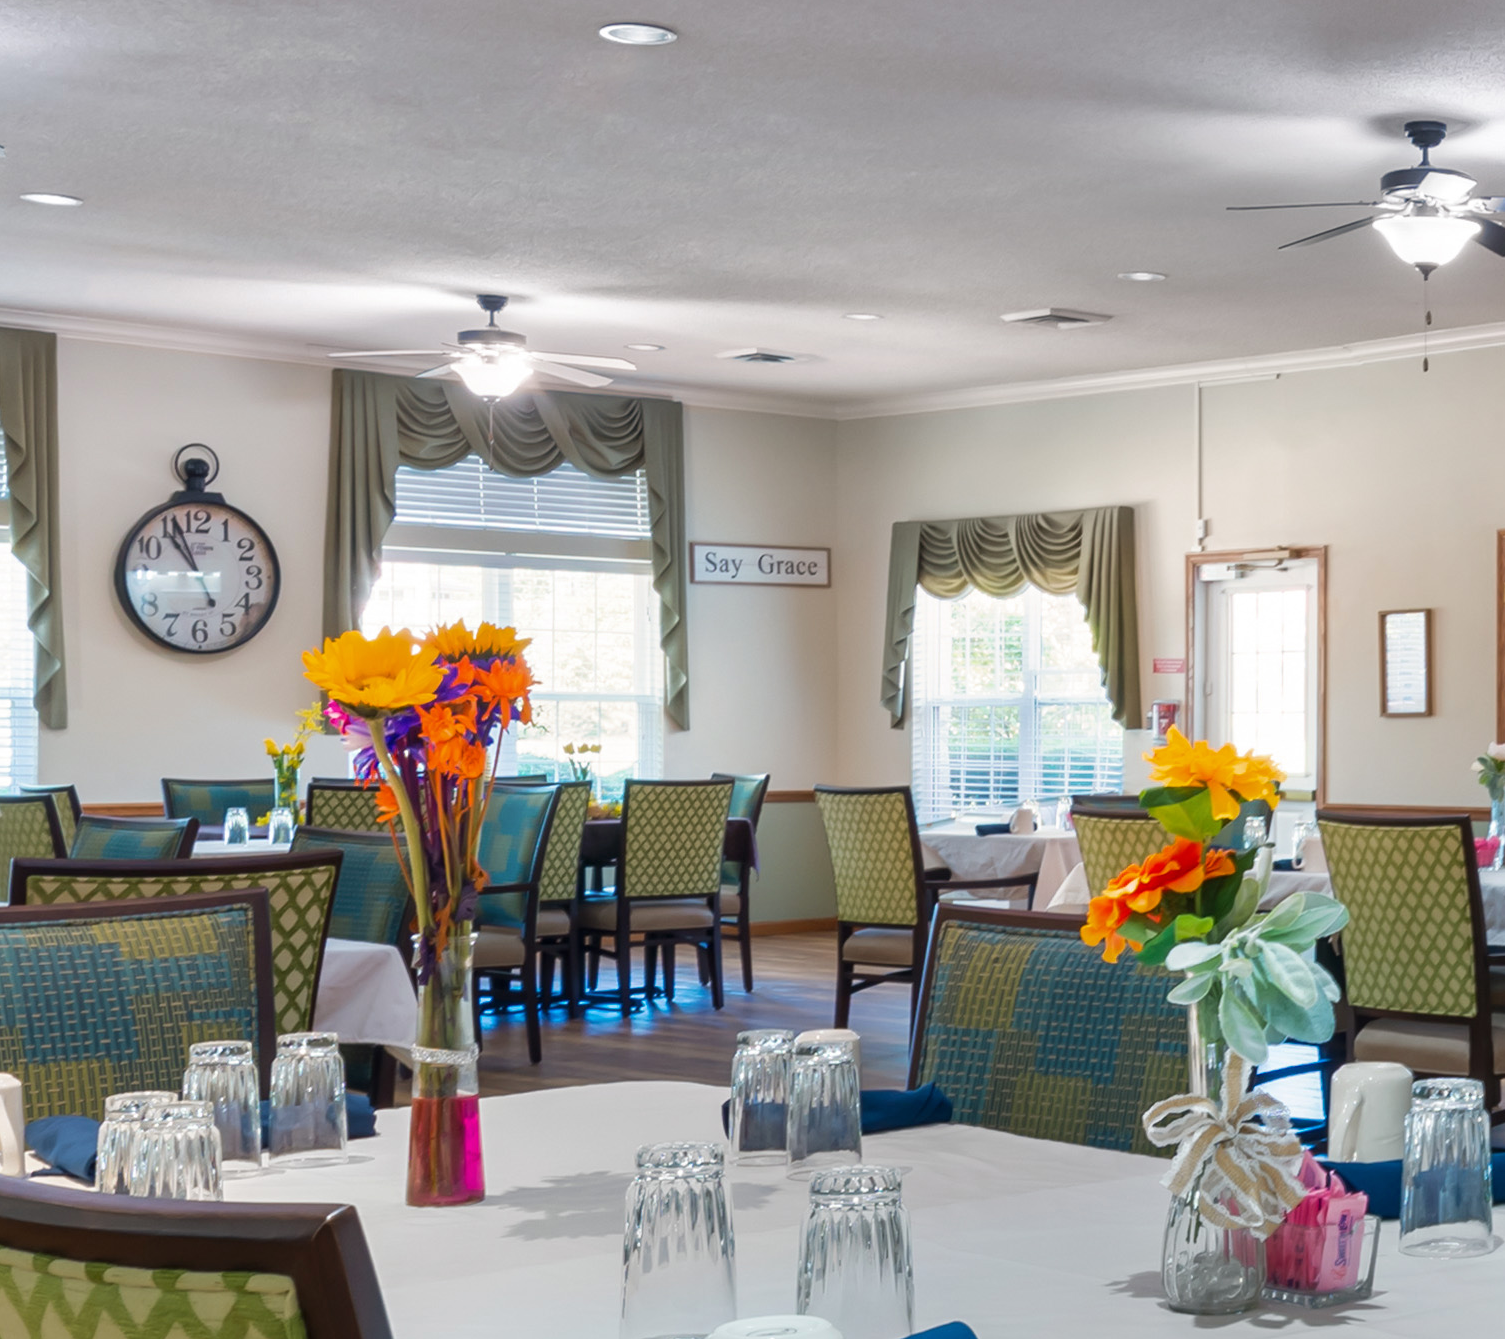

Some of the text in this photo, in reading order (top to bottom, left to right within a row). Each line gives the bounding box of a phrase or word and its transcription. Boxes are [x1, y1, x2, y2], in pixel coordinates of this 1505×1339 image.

[185, 509, 211, 534] 12
[221, 518, 231, 542] 1
[137, 535, 162, 560] 10
[236, 537, 255, 561] 2
[245, 565, 262, 590] 3
[705, 551, 818, 579] Say Grace
[141, 592, 159, 617] 8
[234, 592, 252, 615] 4
[162, 613, 180, 637] 7
[191, 619, 208, 644] 6
[220, 613, 236, 637] 5
